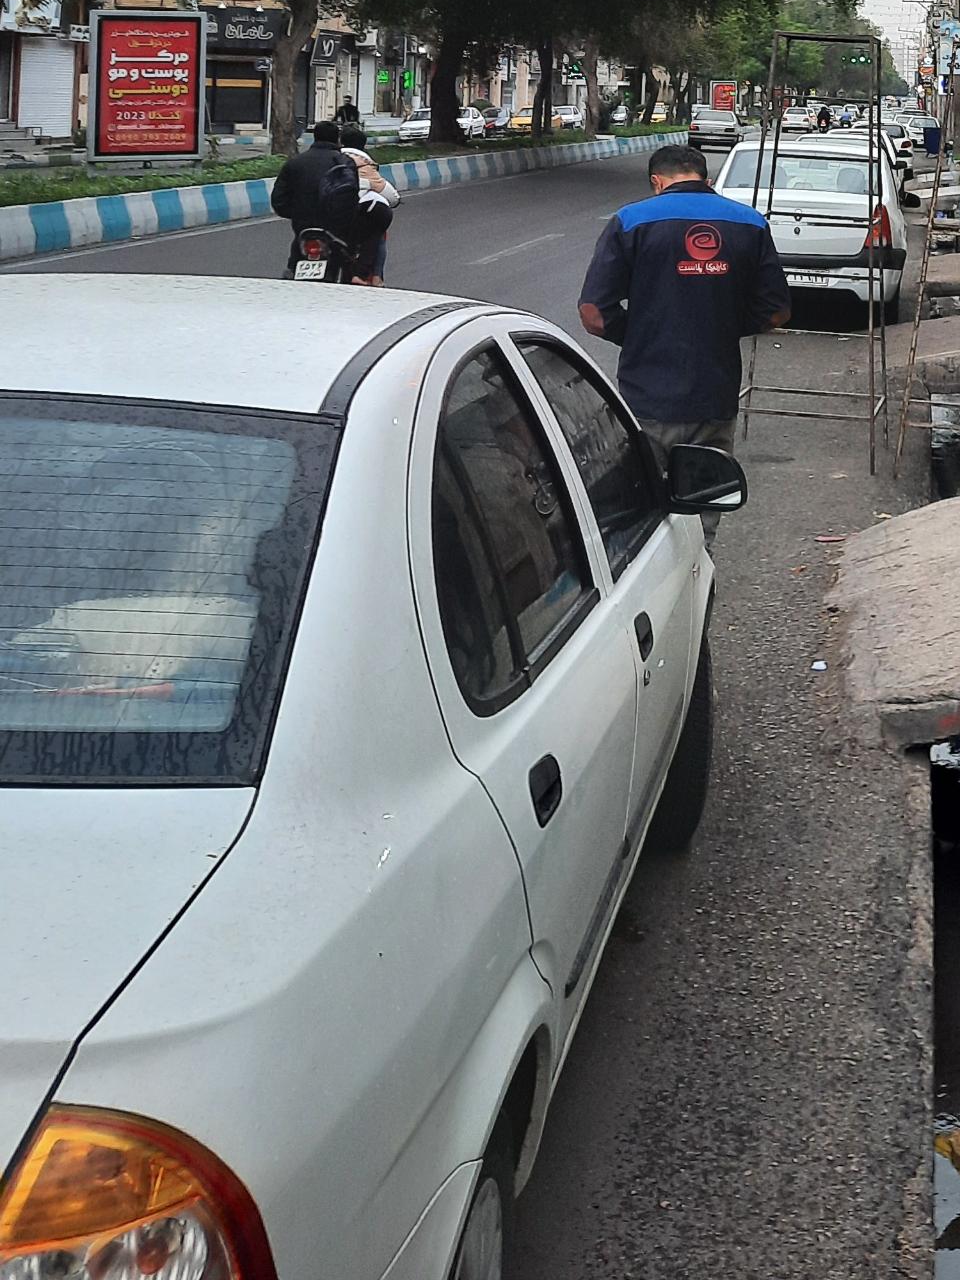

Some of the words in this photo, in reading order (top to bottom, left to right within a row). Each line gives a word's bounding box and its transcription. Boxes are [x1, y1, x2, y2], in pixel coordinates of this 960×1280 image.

[109, 48, 189, 65] مرکز
[108, 68, 128, 81] مو
[129, 68, 140, 81] و
[141, 68, 189, 82] پوست
[108, 81, 189, 99] دوستی
[116, 111, 146, 120] 2023
